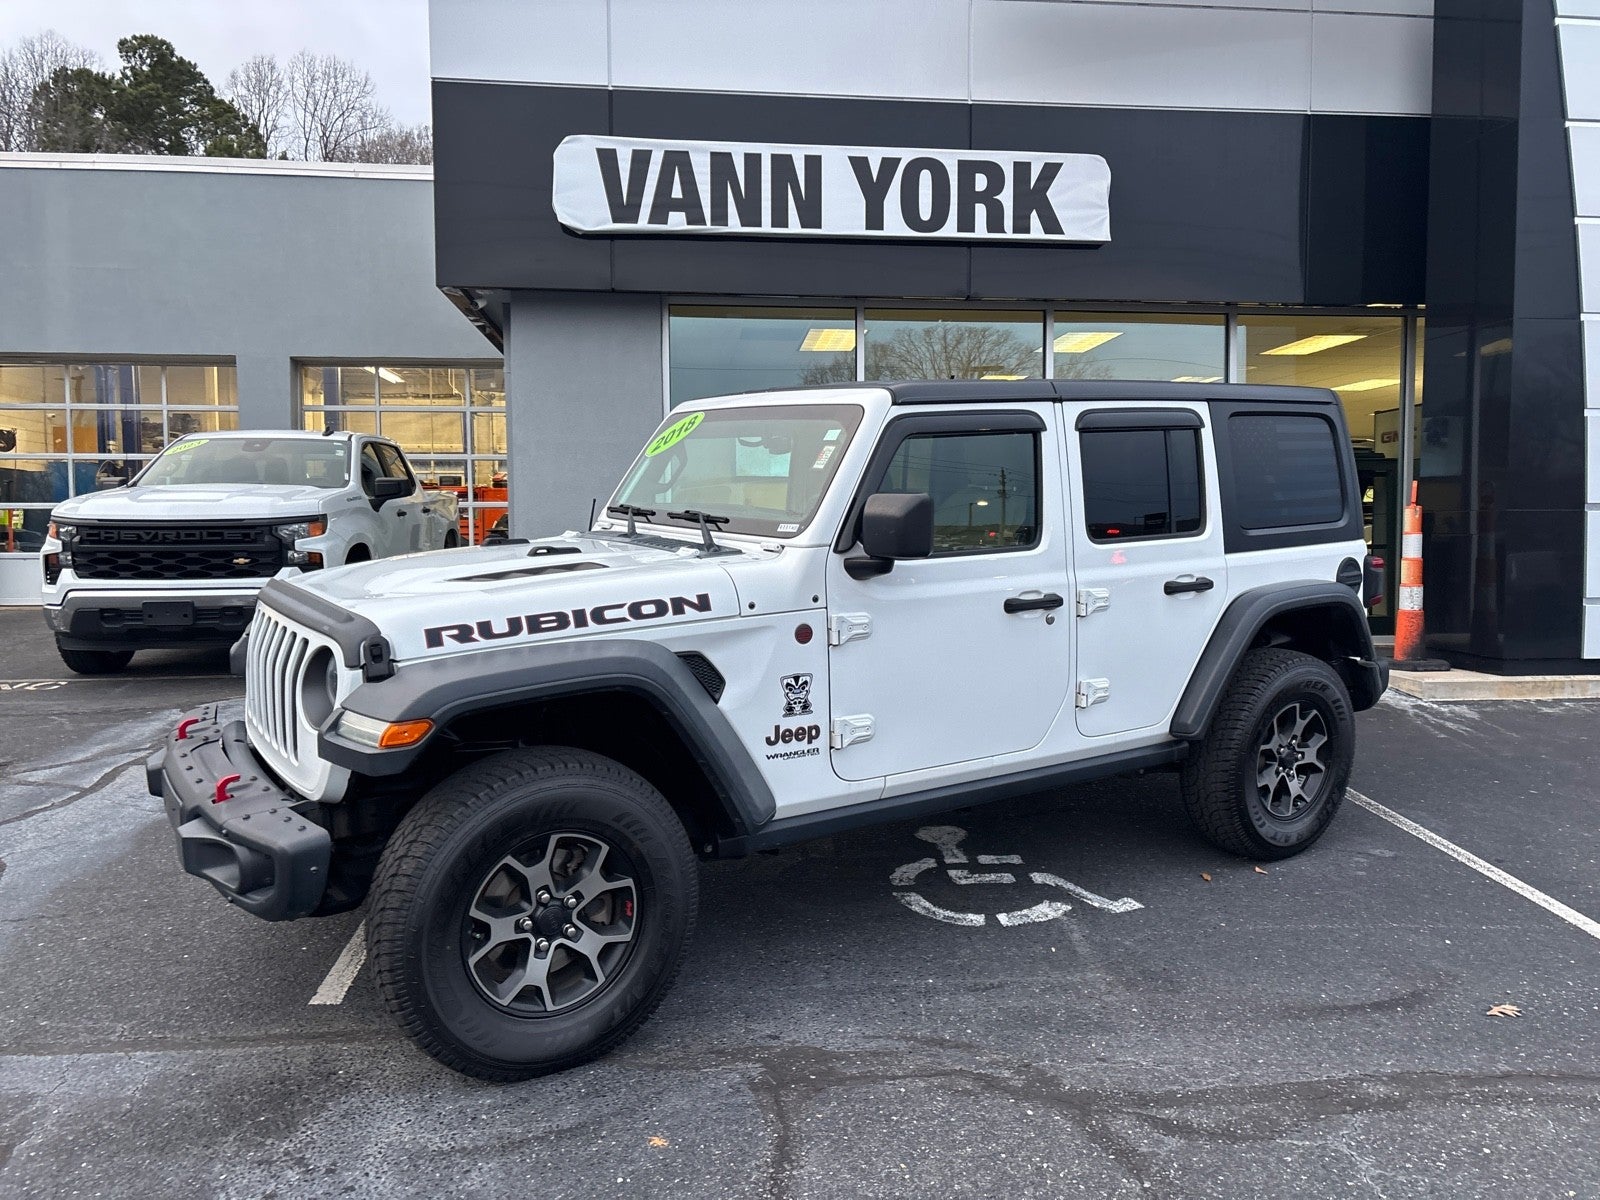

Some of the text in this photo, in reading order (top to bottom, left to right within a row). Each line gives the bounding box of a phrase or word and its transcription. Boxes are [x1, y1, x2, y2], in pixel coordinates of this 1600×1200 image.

[595, 147, 1065, 235] VANN YORK
[650, 414, 699, 454] 2018
[84, 528, 264, 542] CHEVROLET
[424, 593, 713, 649] RUBICON
[765, 724, 821, 746] Jeep
[765, 747, 820, 760] WRANGLER
